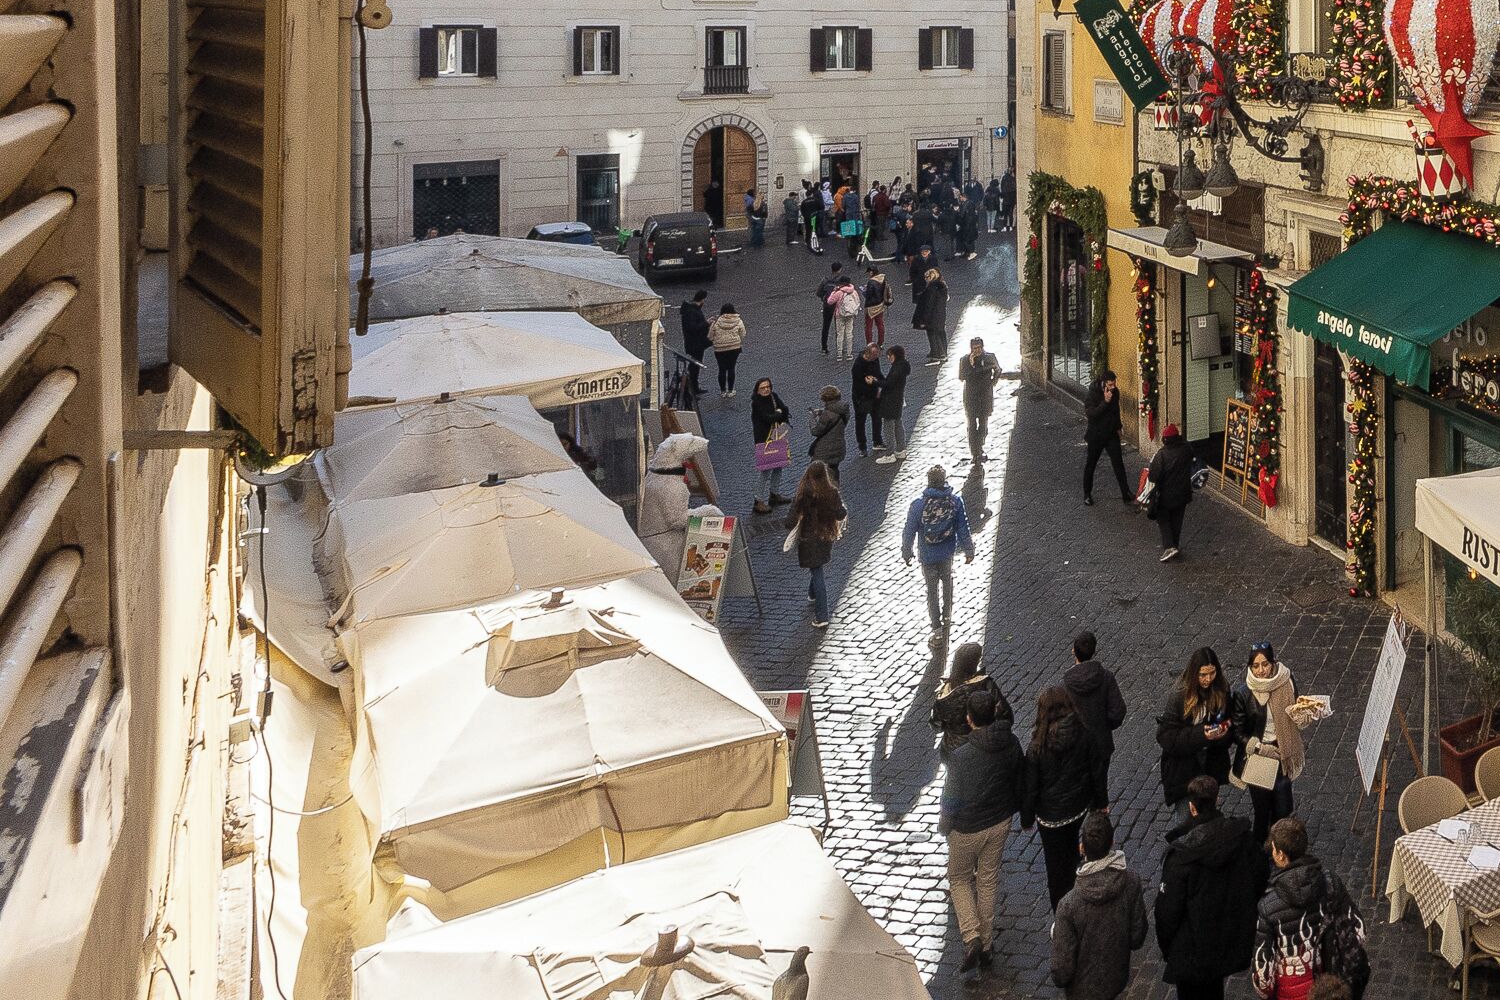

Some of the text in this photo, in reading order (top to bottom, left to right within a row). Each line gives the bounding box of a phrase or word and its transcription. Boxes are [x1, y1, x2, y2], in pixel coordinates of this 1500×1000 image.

[1289, 219, 1296, 230] 13
[1317, 310, 1393, 354] angelo feroci
[577, 376, 620, 396] MATER
